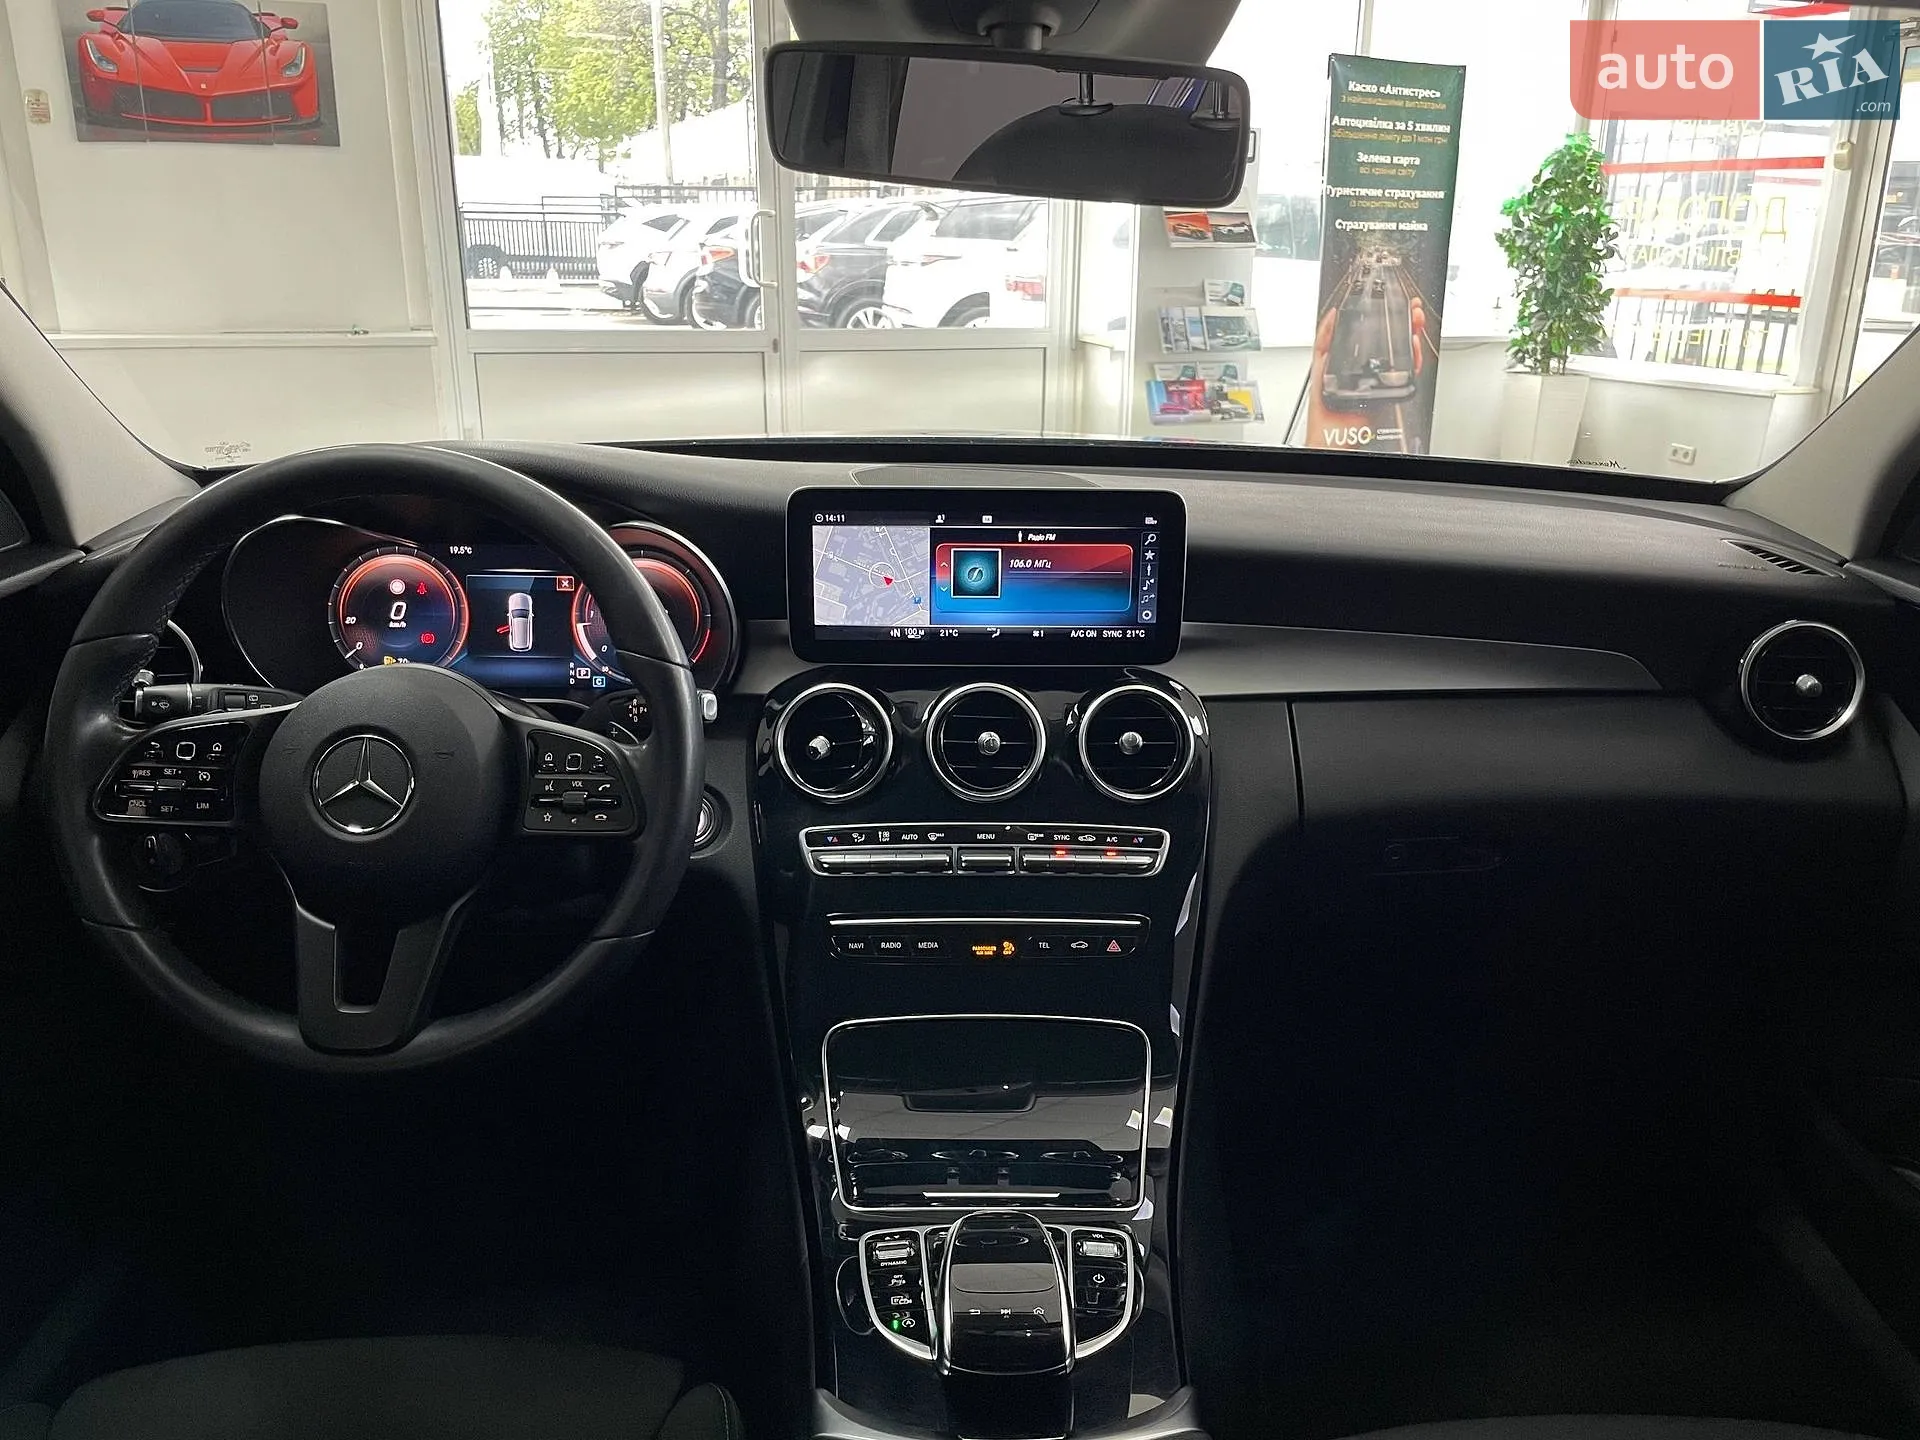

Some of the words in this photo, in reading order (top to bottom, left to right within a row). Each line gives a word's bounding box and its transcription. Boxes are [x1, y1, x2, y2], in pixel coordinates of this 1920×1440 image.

[1348, 80, 1377, 94] Каско
[1332, 115, 1393, 129] Автоцивілка
[1395, 122, 1406, 131] за
[1407, 121, 1414, 131] 5
[1415, 123, 1451, 133] хвилин
[1356, 151, 1391, 164] Зелена
[1393, 155, 1420, 167] карта
[1385, 188, 1445, 200] страхування
[1335, 219, 1397, 232] Страхування
[1398, 220, 1428, 231] майна
[1322, 425, 1372, 446] VUSO
[825, 514, 845, 523] 14:11
[1045, 533, 1056, 541] FM
[449, 546, 473, 554] 19.5°C
[1009, 559, 1032, 568] 106.0
[1034, 559, 1052, 569] МГц
[390, 601, 407, 621] 0
[345, 616, 356, 625] 20
[904, 627, 917, 636] 100
[939, 629, 959, 637] 21°C
[1070, 629, 1084, 638] A/C
[1086, 629, 1097, 638] ON
[1102, 629, 1122, 638] SYNC
[1126, 629, 1145, 638] 21°C
[356, 641, 363, 650] 0
[601, 644, 608, 652] 0
[632, 698, 638, 706] R
[880, 941, 902, 949] RADIO
[918, 941, 939, 949] MEDIA
[880, 1259, 908, 1267] DYNAMIC
